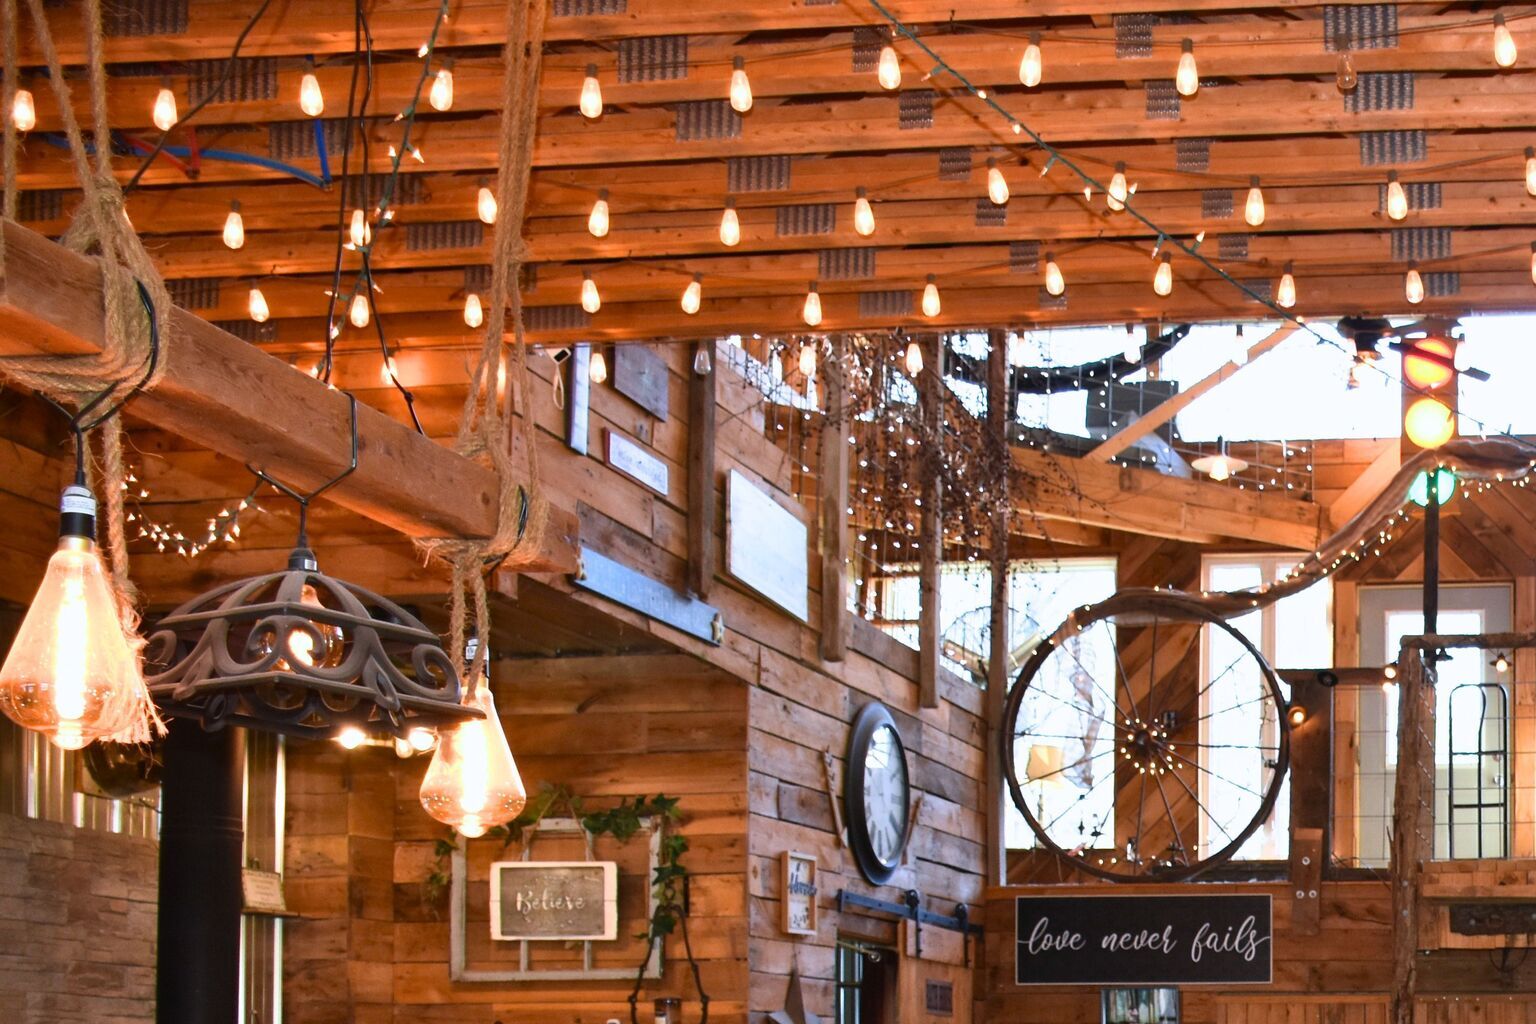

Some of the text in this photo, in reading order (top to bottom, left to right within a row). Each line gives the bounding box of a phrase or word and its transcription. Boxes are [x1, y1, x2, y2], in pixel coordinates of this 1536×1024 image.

[516, 887, 585, 915] Believe
[1027, 915, 1271, 962] love never fails
